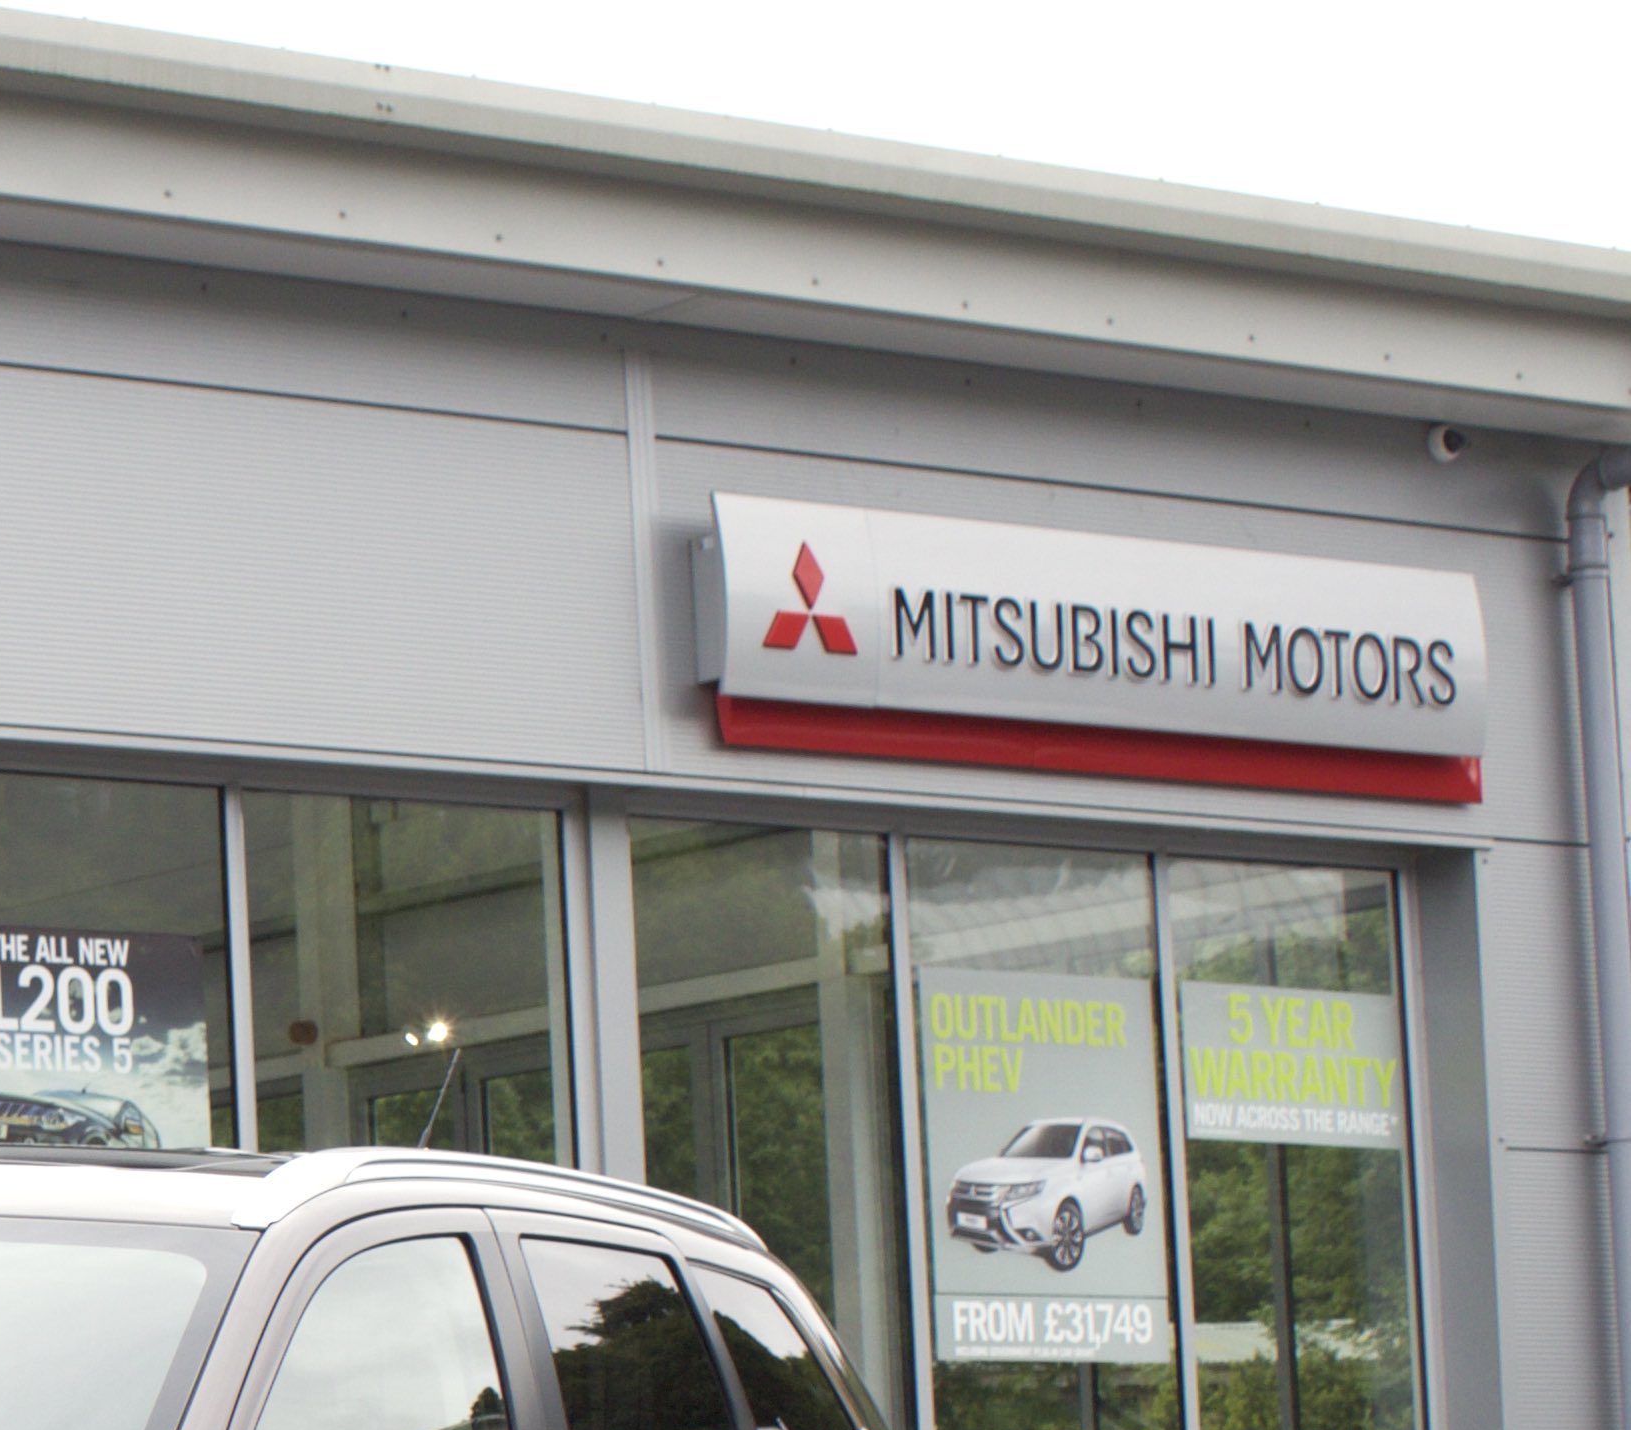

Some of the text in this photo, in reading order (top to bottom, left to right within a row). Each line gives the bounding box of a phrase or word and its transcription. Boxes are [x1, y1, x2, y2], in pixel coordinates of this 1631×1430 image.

[891, 586, 1458, 708] MITSUBISHI MOTORS
[36, 935, 74, 965] ALL
[78, 938, 130, 968] NEW
[930, 992, 1127, 1048] OUTLANDER
[1227, 992, 1355, 1052] 5 YEAR
[112, 1037, 134, 1074] 5
[932, 1042, 1023, 1094] PHEV
[1188, 1046, 1397, 1109] WARRANTY
[1193, 1102, 1234, 1128] NOW
[1237, 1104, 1301, 1131] ACROSS
[1303, 1107, 1335, 1133] THE
[952, 1300, 1154, 1350] FROM £31,749
